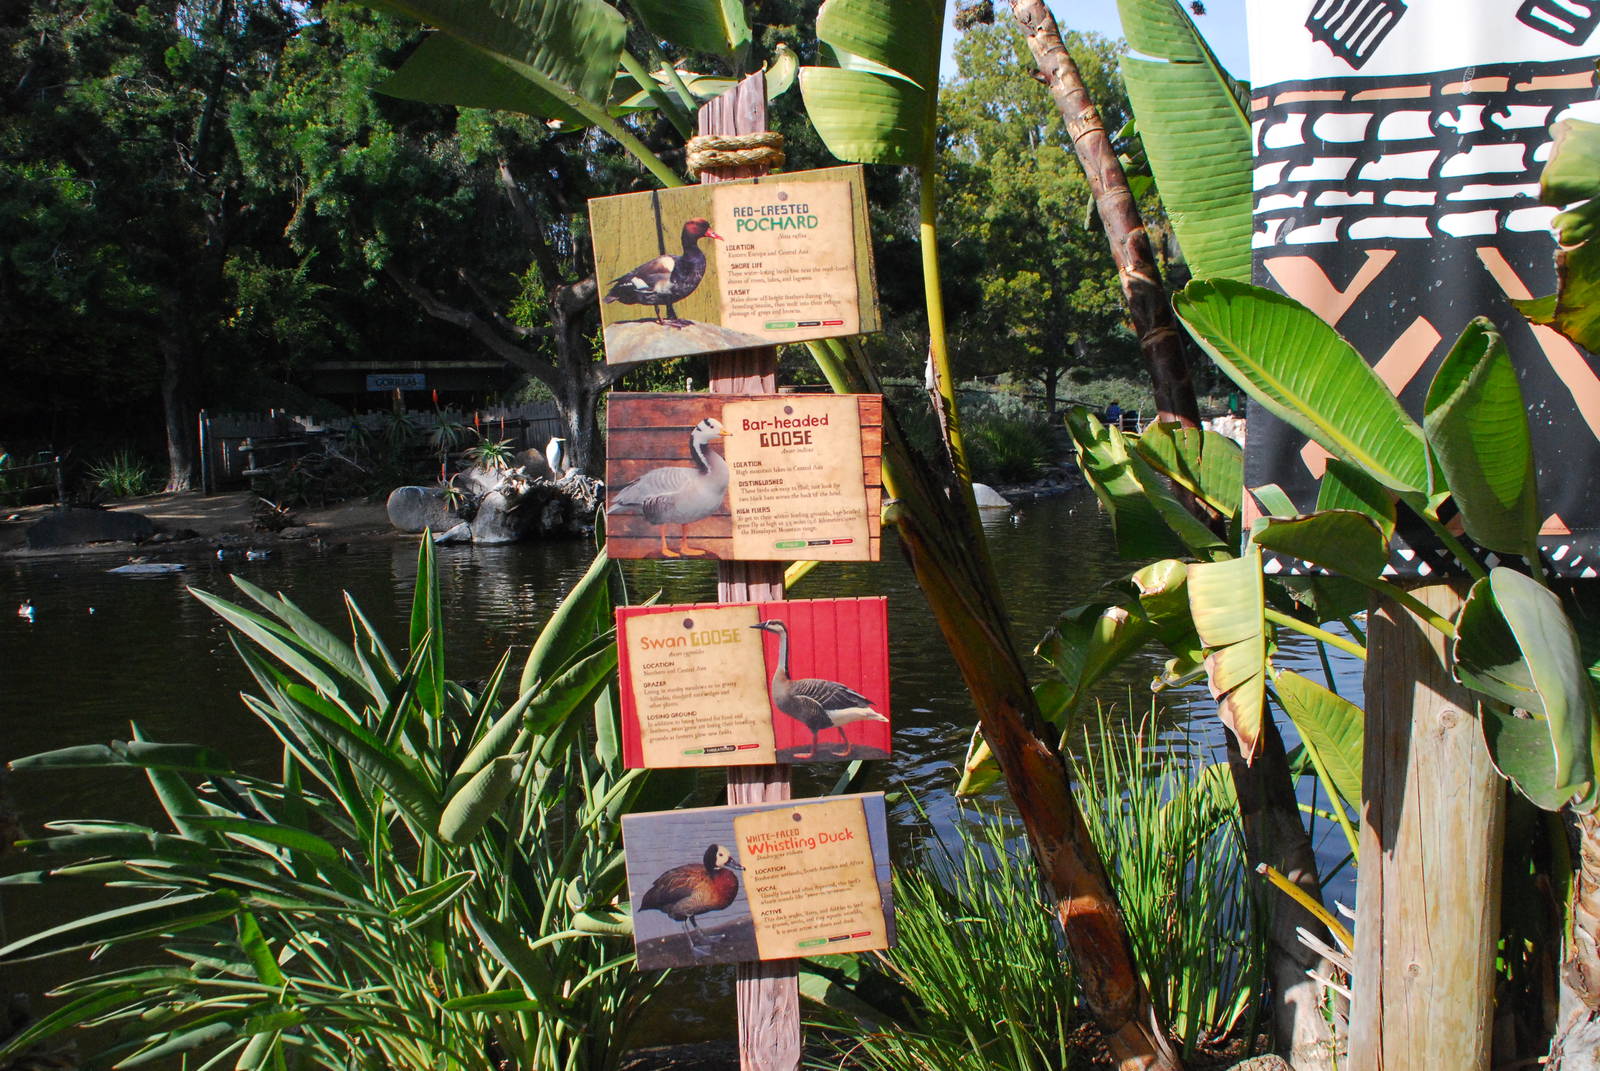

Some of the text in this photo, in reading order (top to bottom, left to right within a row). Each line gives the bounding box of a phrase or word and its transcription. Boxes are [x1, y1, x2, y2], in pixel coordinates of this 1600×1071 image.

[733, 204, 809, 217] RED-CRESTED
[736, 214, 818, 232] POCHARD
[376, 378, 416, 386] GORILLAS
[742, 413, 829, 431] Bar-headed
[760, 430, 813, 448] GOOSE
[640, 628, 742, 650] Swan GOOSE
[746, 828, 800, 844] WHITE-FACED
[748, 827, 854, 855] Whistling Duck
[755, 866, 786, 875] LOCATION
